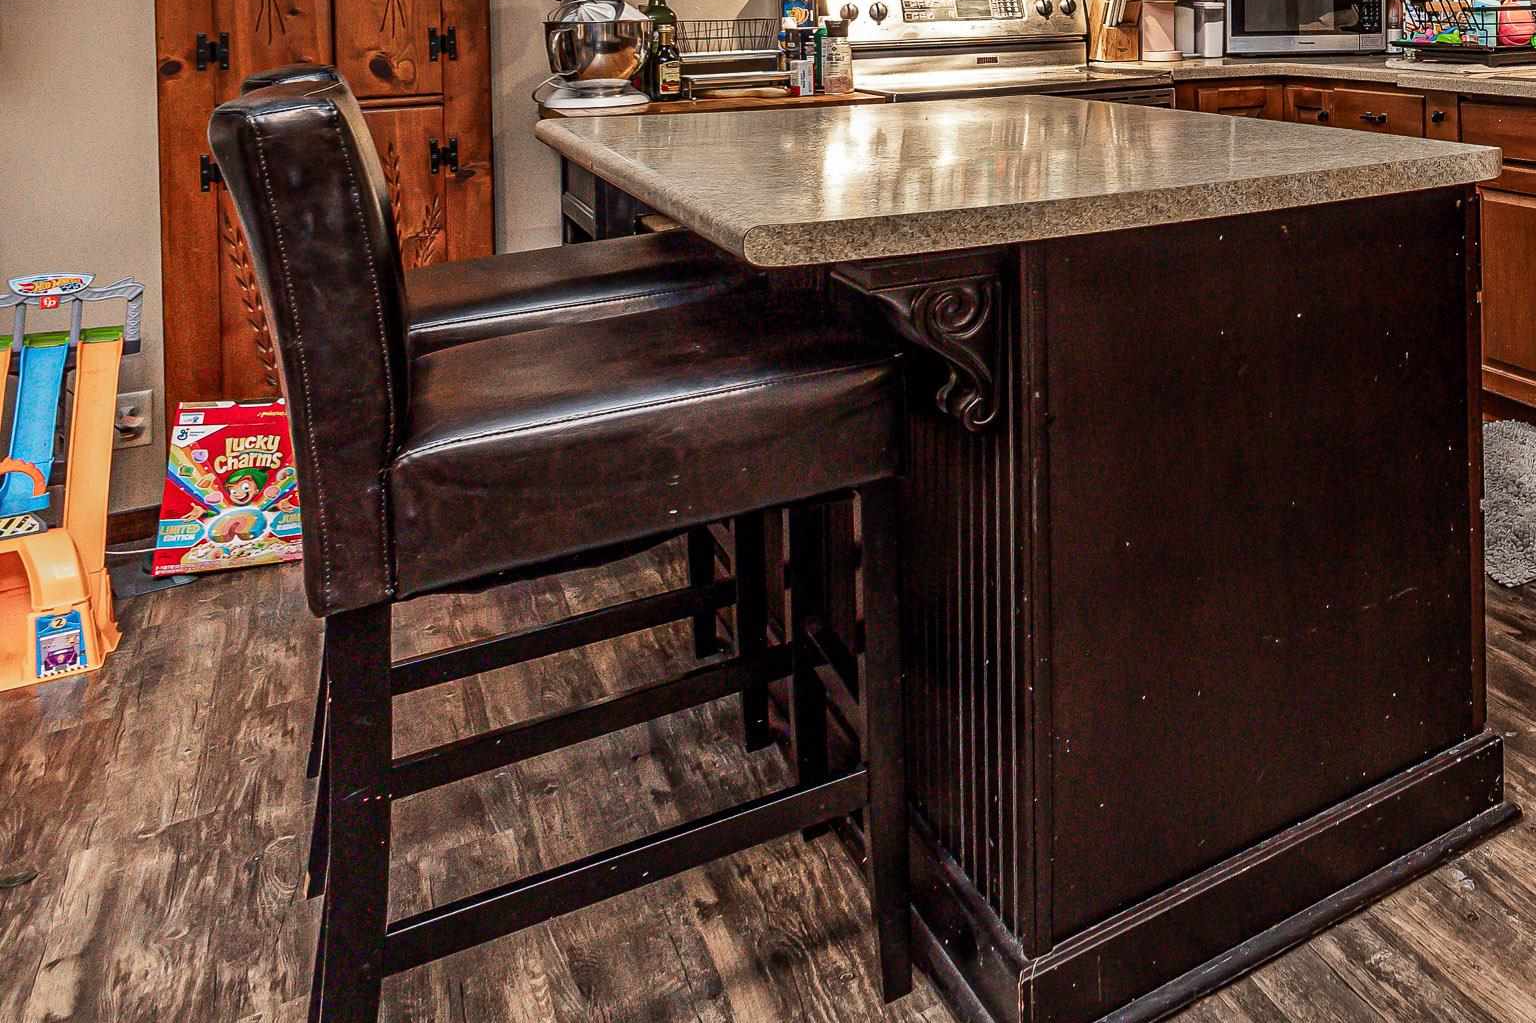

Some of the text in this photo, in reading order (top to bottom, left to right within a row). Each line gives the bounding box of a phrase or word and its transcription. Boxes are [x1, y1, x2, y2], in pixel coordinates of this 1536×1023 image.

[225, 435, 281, 457] Lucky
[213, 451, 283, 474] Charms
[55, 618, 63, 627] 2
